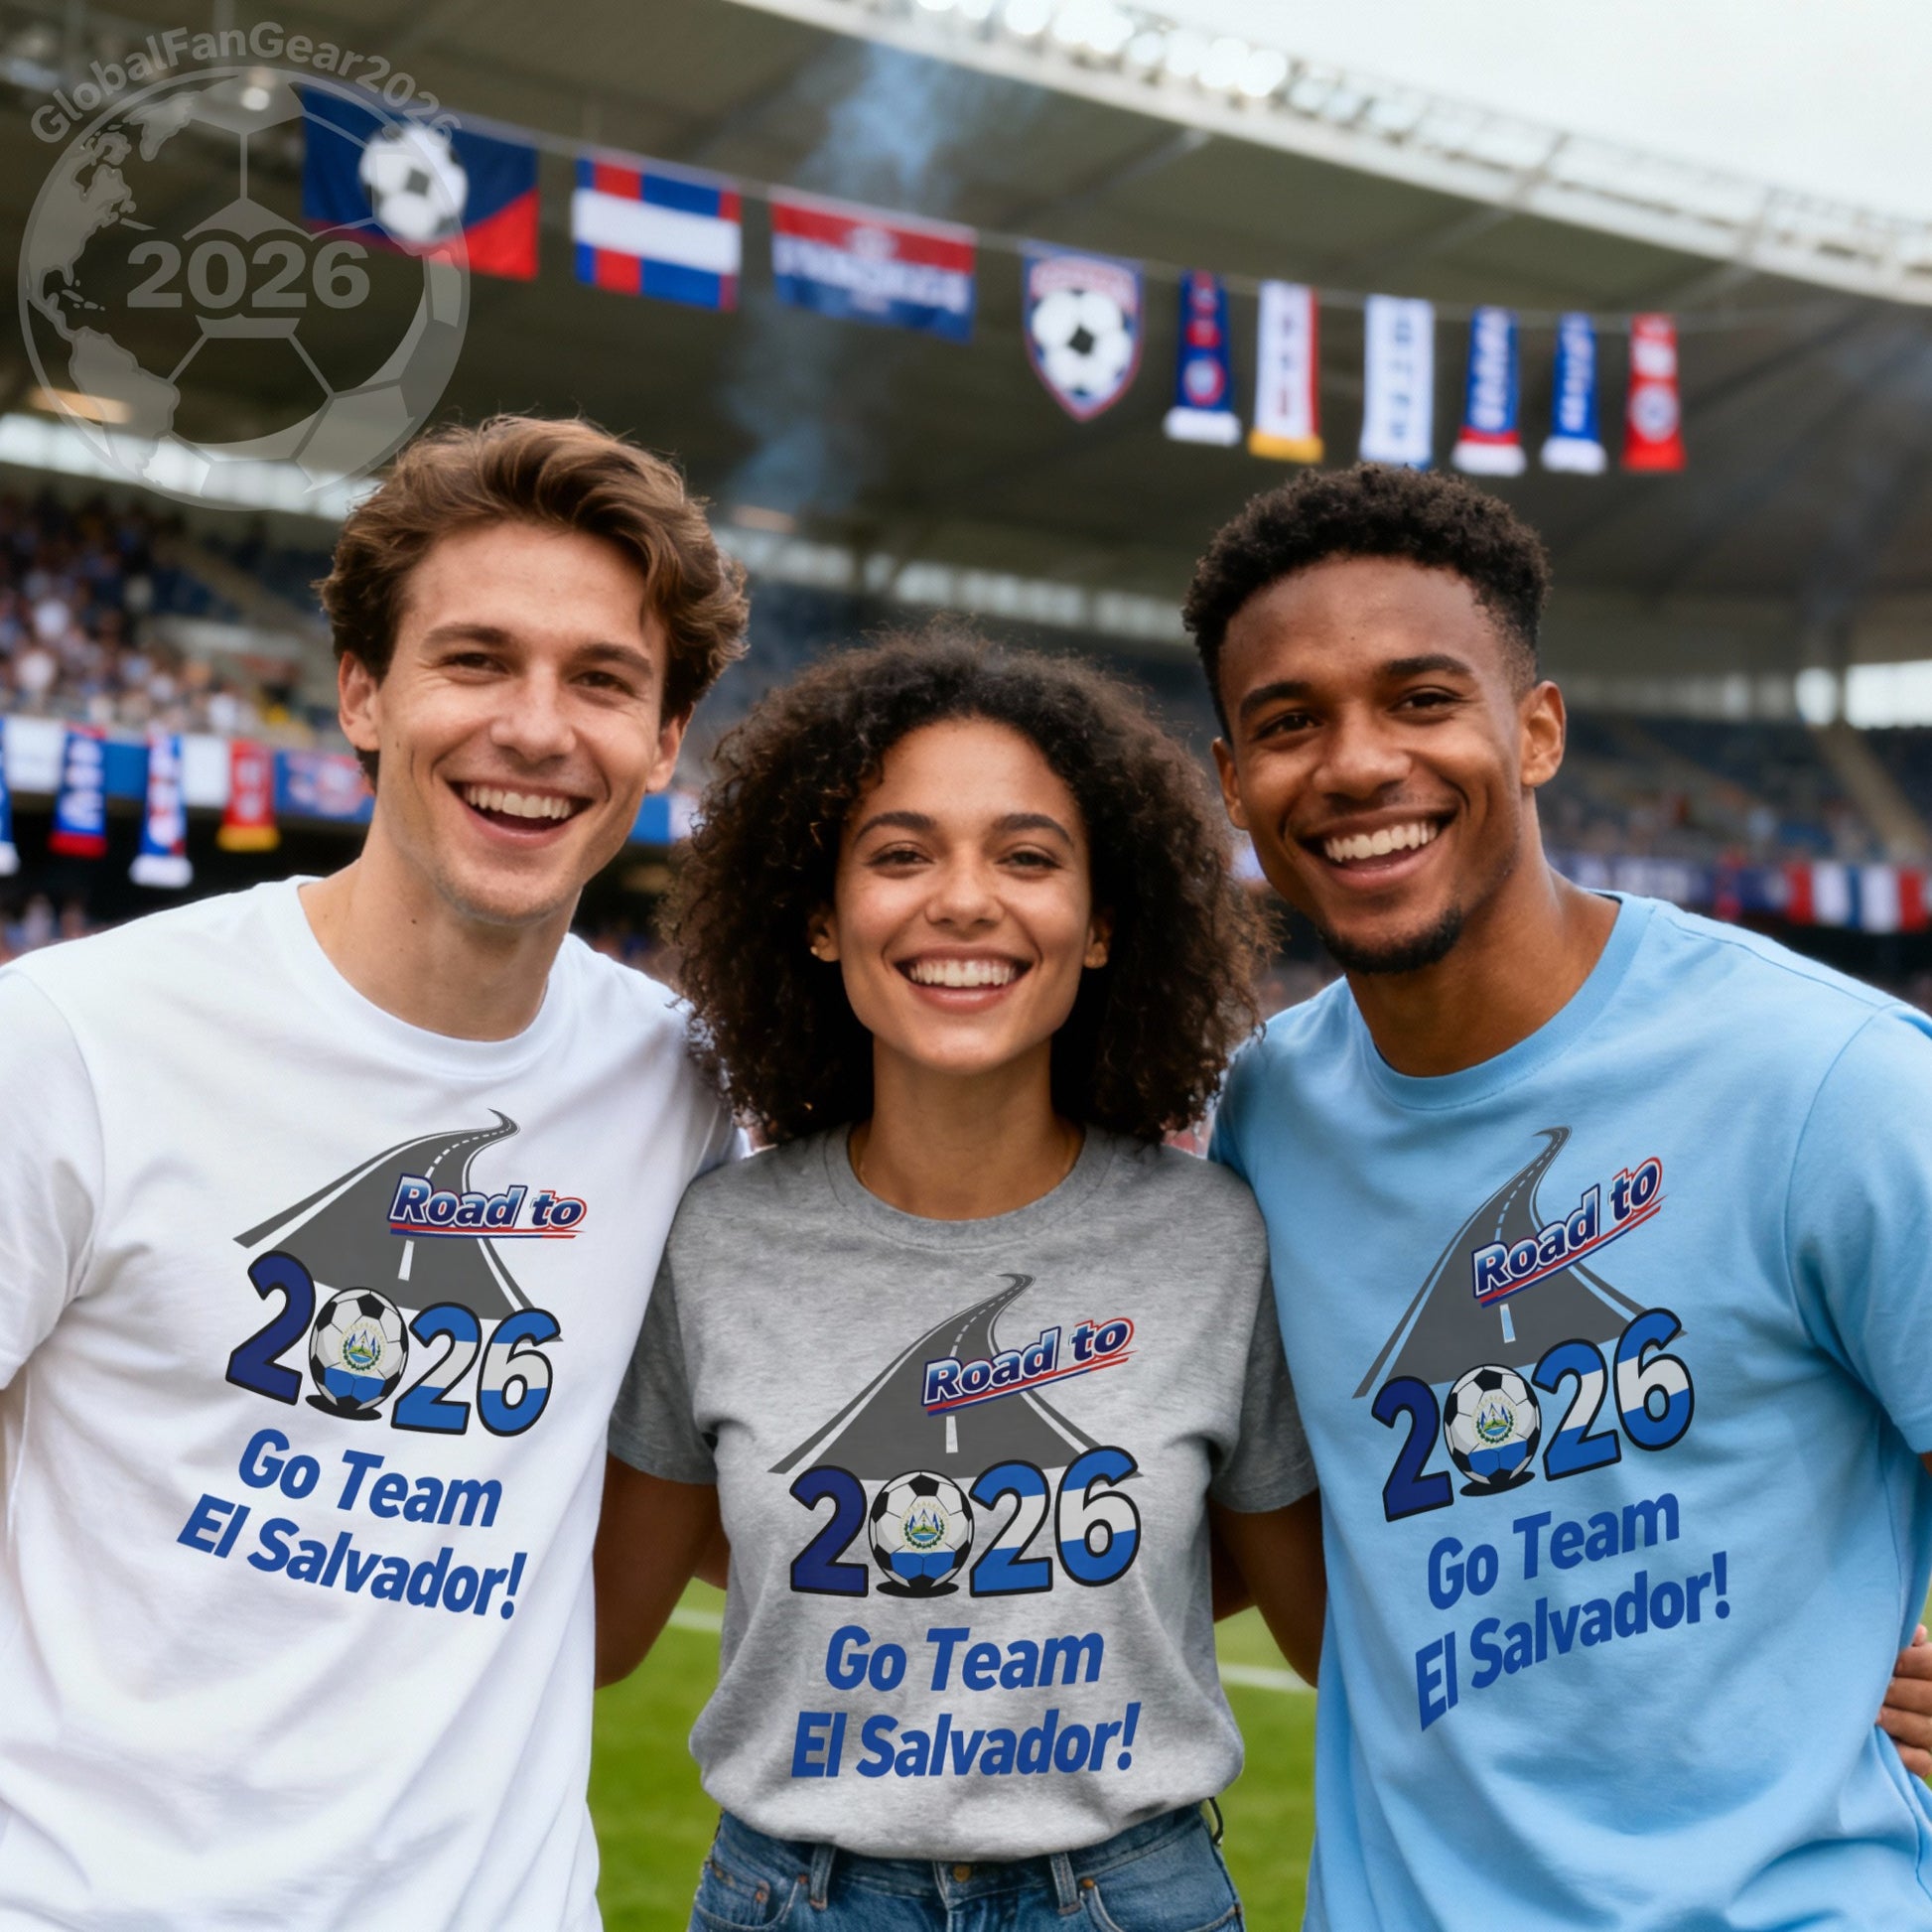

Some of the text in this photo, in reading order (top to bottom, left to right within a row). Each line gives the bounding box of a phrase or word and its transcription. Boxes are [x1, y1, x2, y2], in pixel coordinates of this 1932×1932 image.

[387, 1173, 587, 1230] Road to
[1471, 1157, 1663, 1299] Road to
[921, 1317, 1135, 1406] Road to
[238, 1429, 502, 1527] Go Team
[177, 1493, 527, 1619] El Salvador!
[1428, 1492, 1680, 1610] Go Team
[825, 1625, 1104, 1692] Go Team
[1416, 1551, 1731, 1732] El Salvador!
[791, 1702, 1142, 1777] El Salvador!
